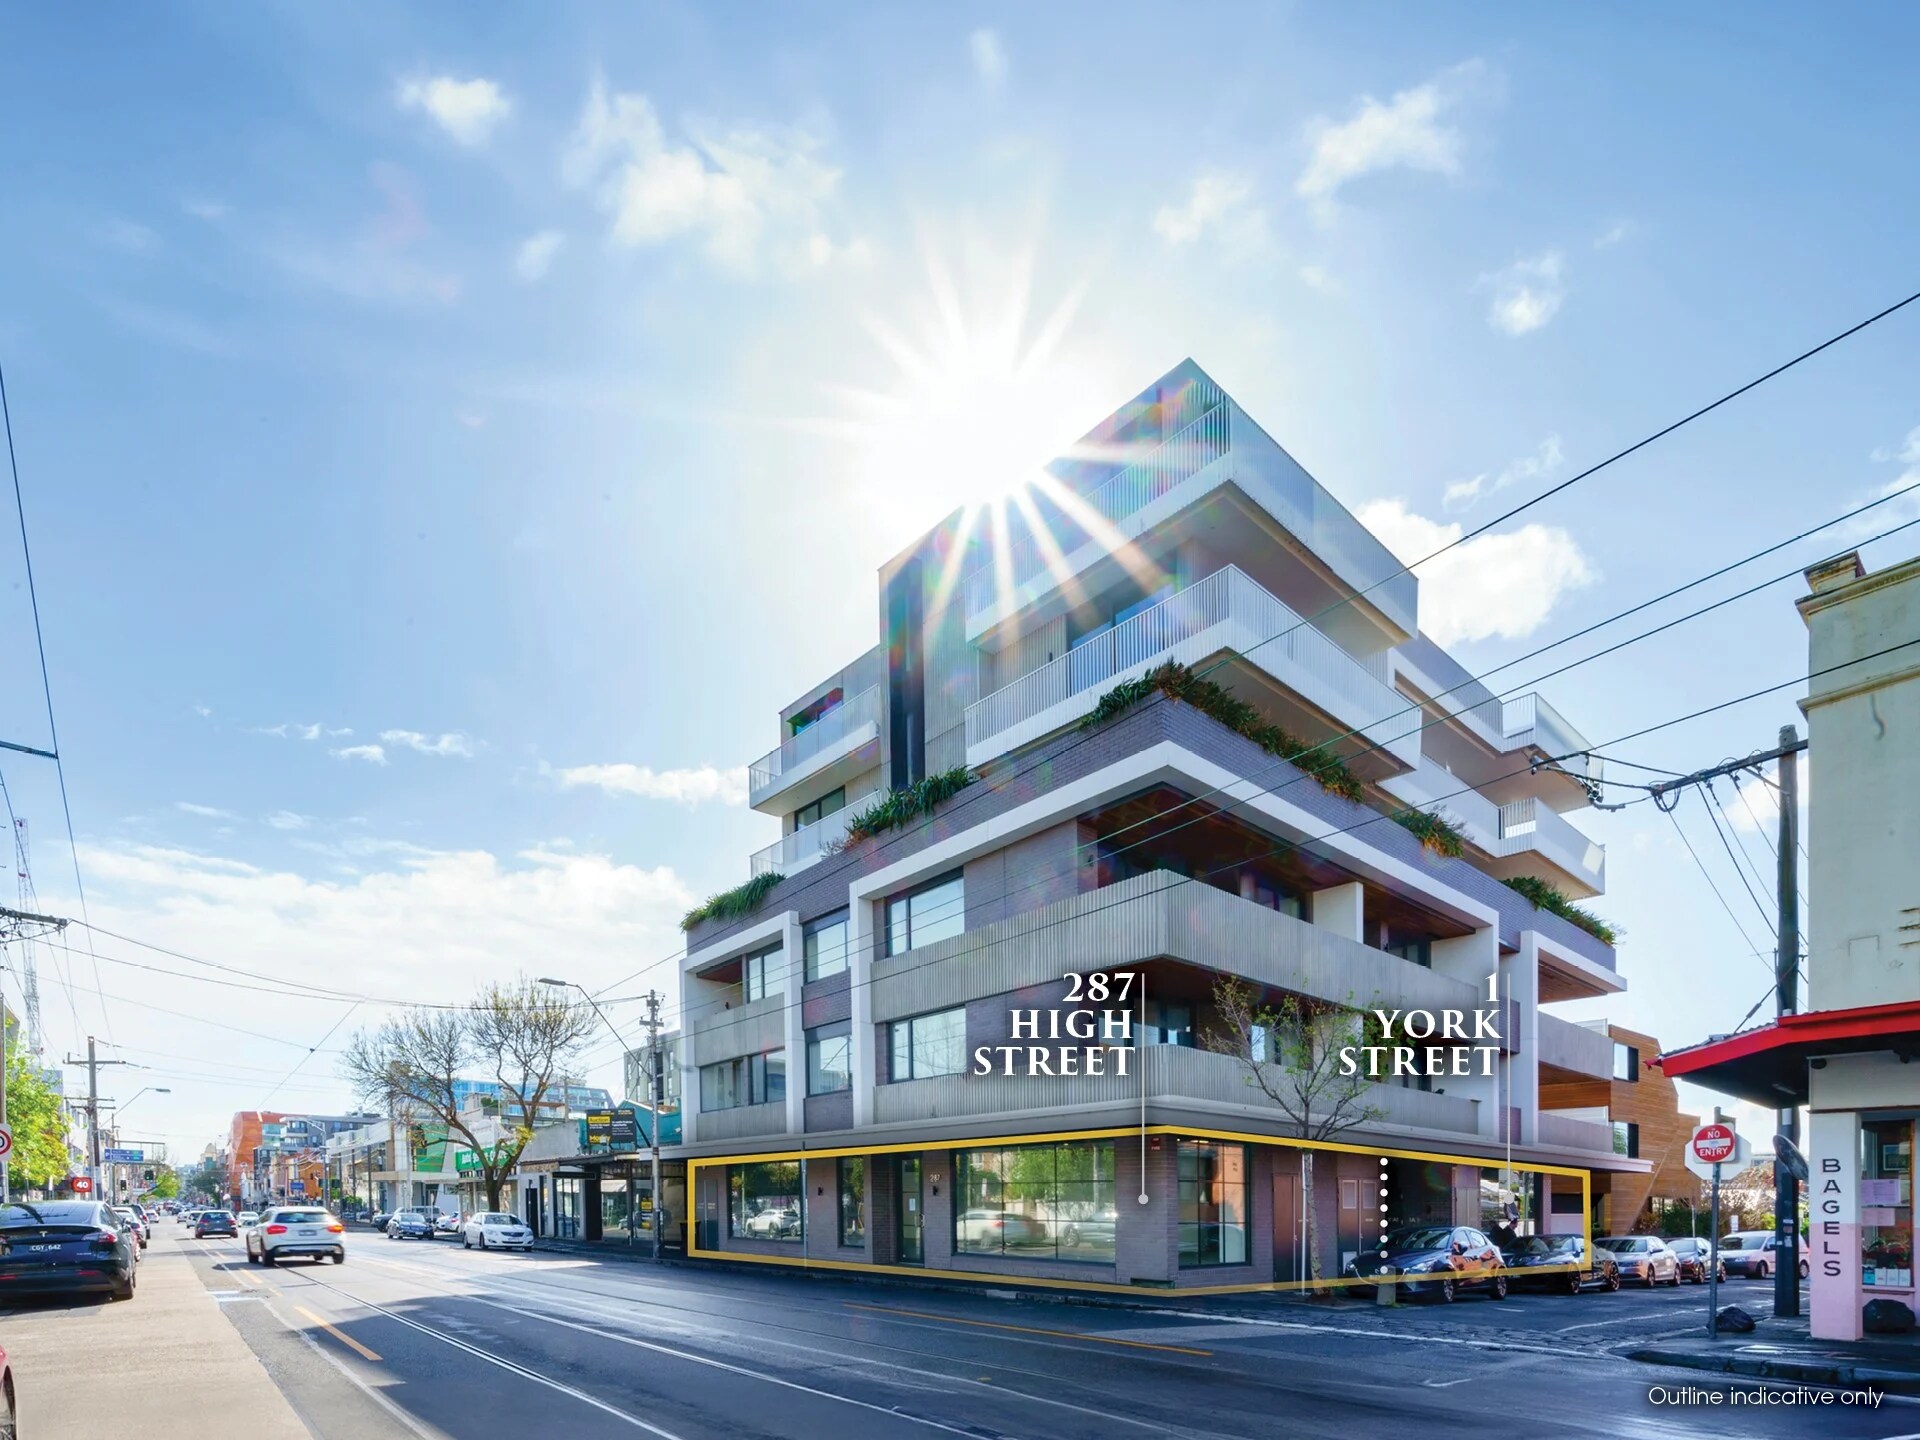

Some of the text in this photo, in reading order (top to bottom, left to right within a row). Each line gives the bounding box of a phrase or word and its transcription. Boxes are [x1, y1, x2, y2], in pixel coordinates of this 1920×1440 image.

[1707, 1130, 1720, 1139] NO
[1699, 1146, 1729, 1157] ENTRY
[930, 1174, 941, 1183] 287
[76, 1181, 89, 1189] 40
[1821, 1158, 1842, 1277] BAGELS
